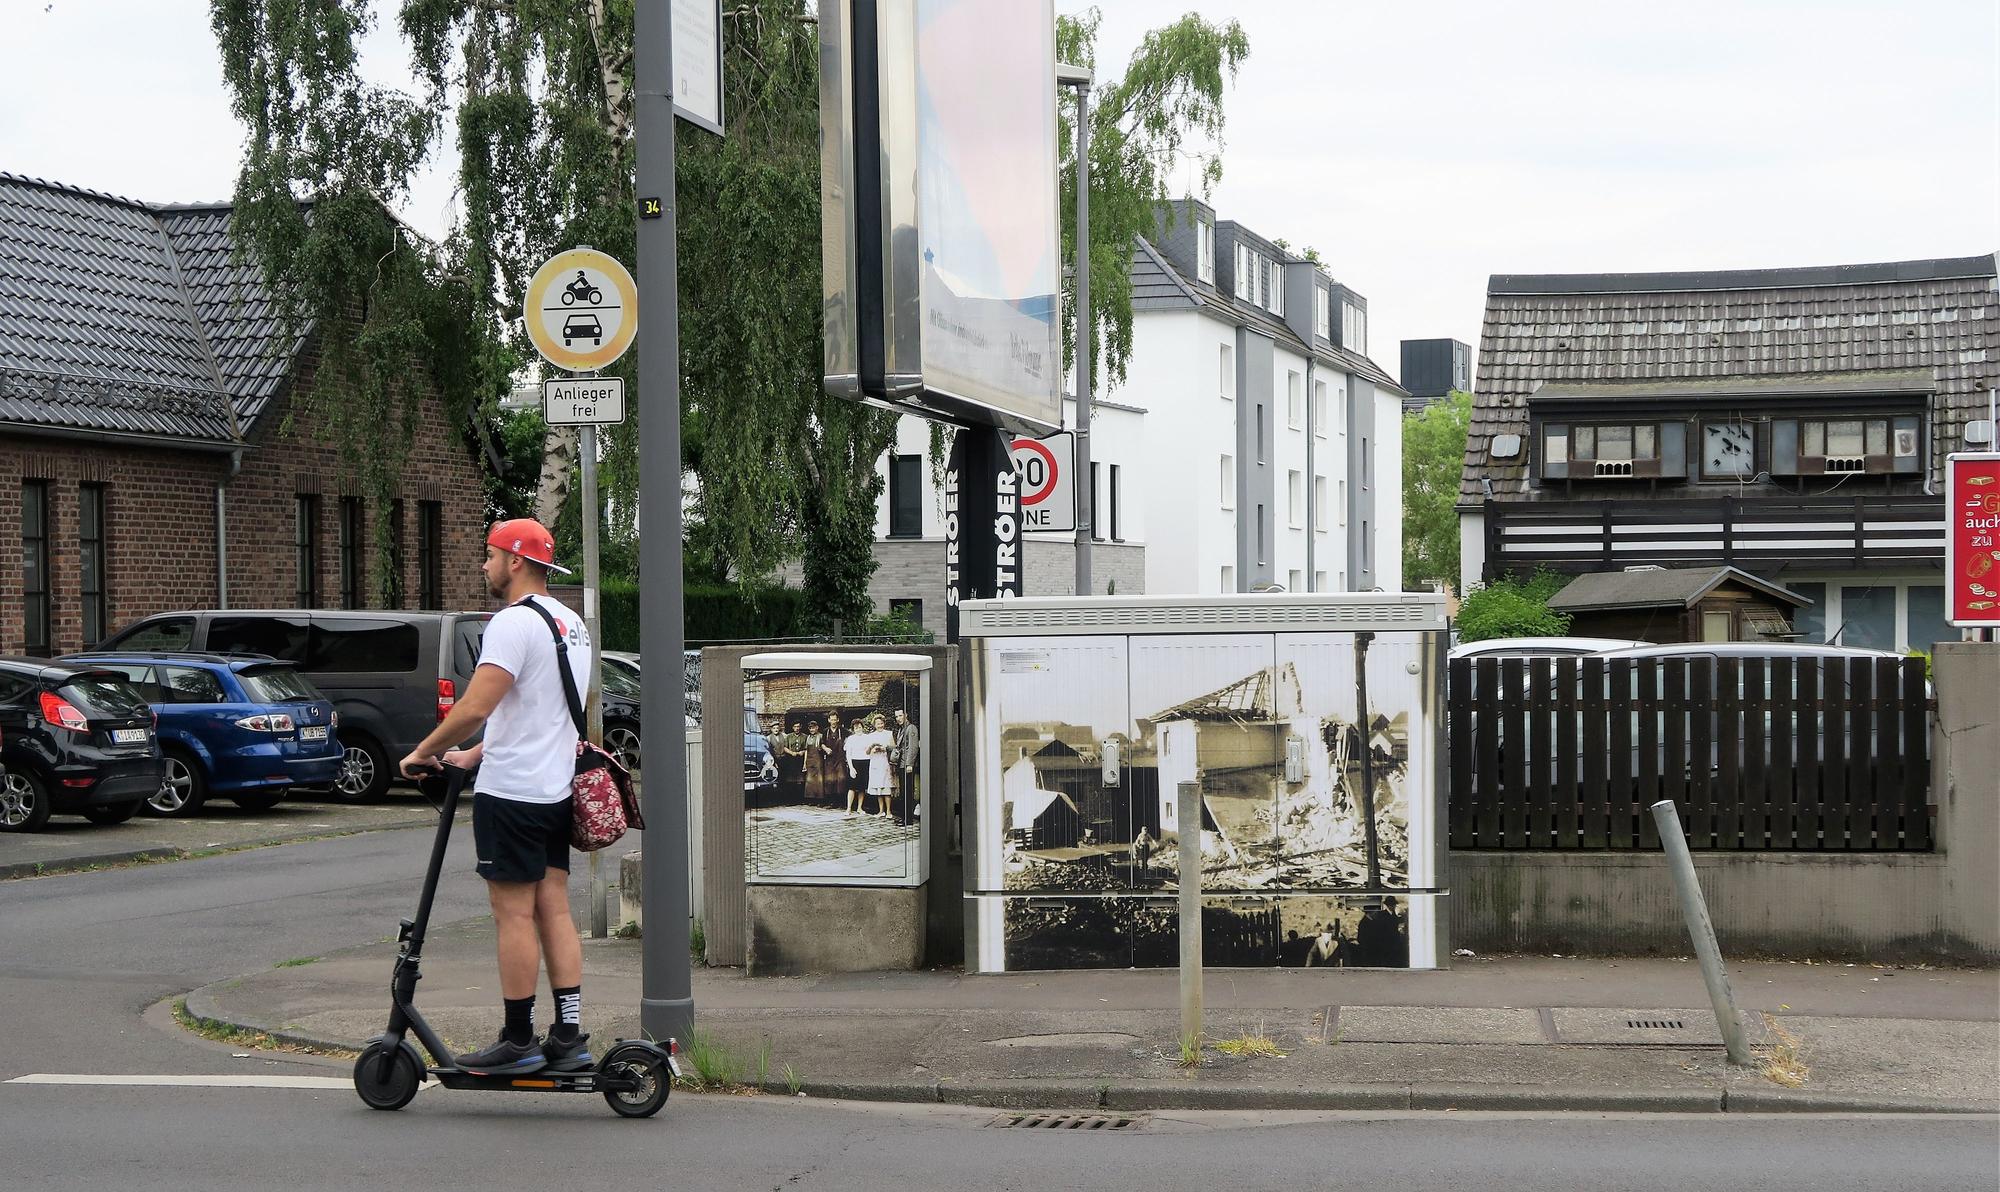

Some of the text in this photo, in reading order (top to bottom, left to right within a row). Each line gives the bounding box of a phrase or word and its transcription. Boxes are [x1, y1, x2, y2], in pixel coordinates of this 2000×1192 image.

[645, 200, 660, 214] 34
[554, 387, 614, 403] Anlieger
[572, 404, 597, 417] frei
[1971, 535, 1993, 547] zu
